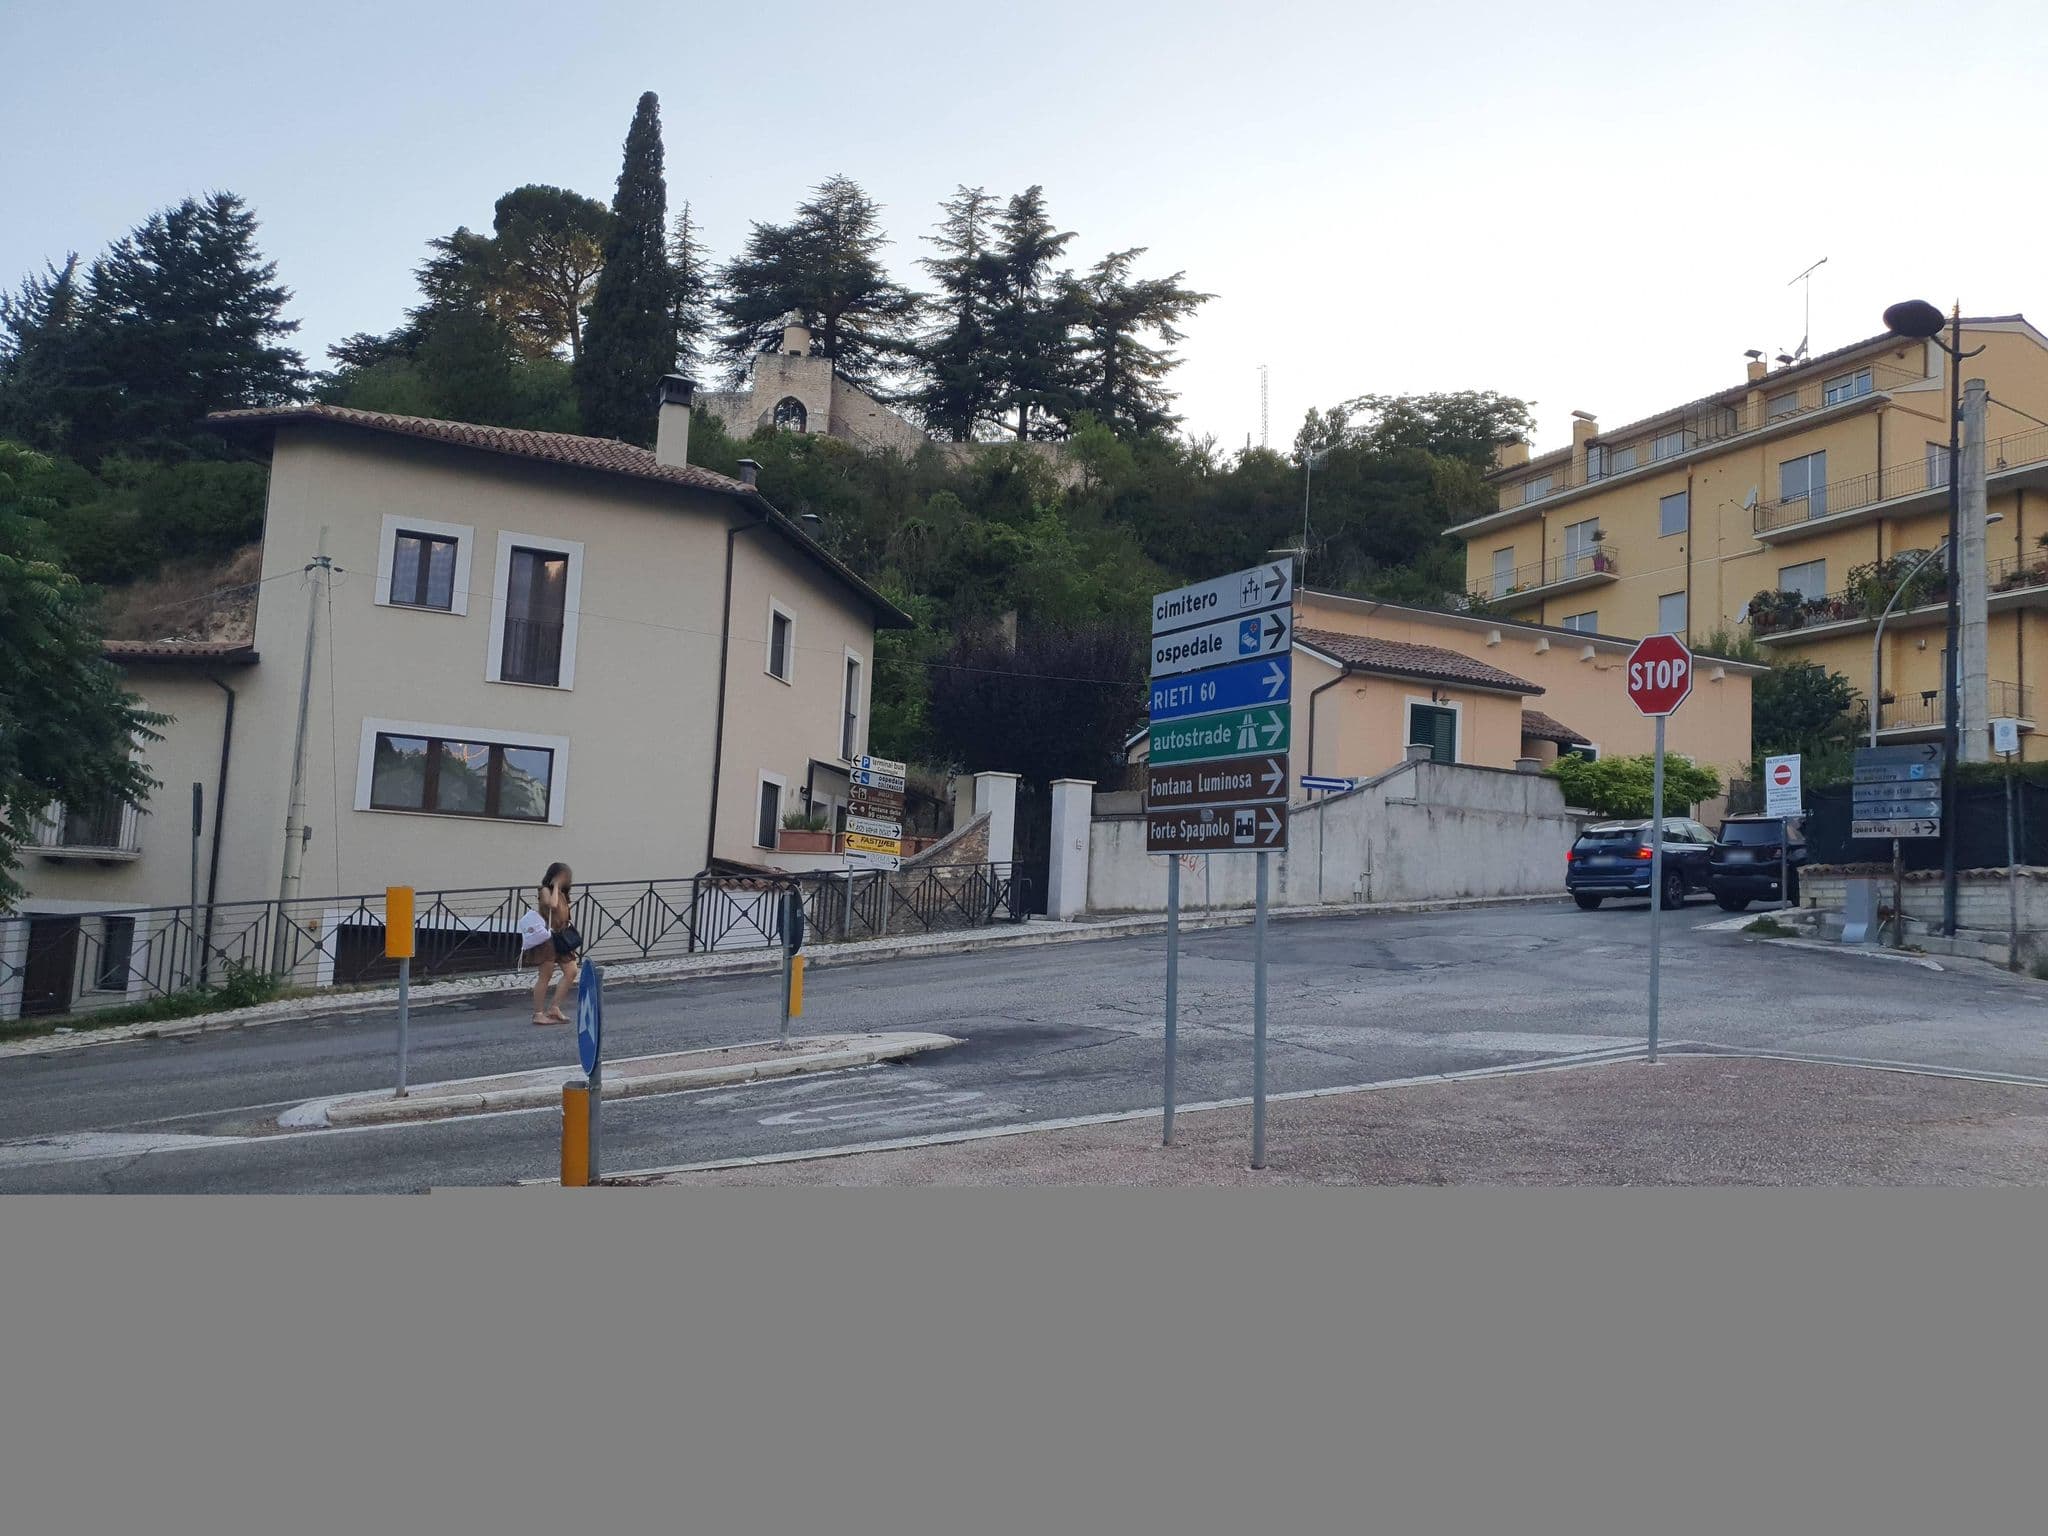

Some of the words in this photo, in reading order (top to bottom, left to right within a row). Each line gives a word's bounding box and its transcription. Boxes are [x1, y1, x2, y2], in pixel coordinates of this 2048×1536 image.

[1156, 590, 1218, 620] cimitero
[1156, 633, 1223, 664] ospedale
[1630, 658, 1687, 691] STOP
[1154, 685, 1193, 710] RIETI
[1200, 681, 1216, 702] 60
[1153, 723, 1232, 751] autostrade
[893, 762, 905, 771] bus
[878, 776, 904, 786] ospedale
[1151, 777, 1193, 797] Fontana
[1198, 771, 1252, 793] Luminosa
[860, 836, 896, 848] FASTWEB
[1151, 818, 1176, 840] Forte
[1180, 814, 1230, 844] Spagnolo
